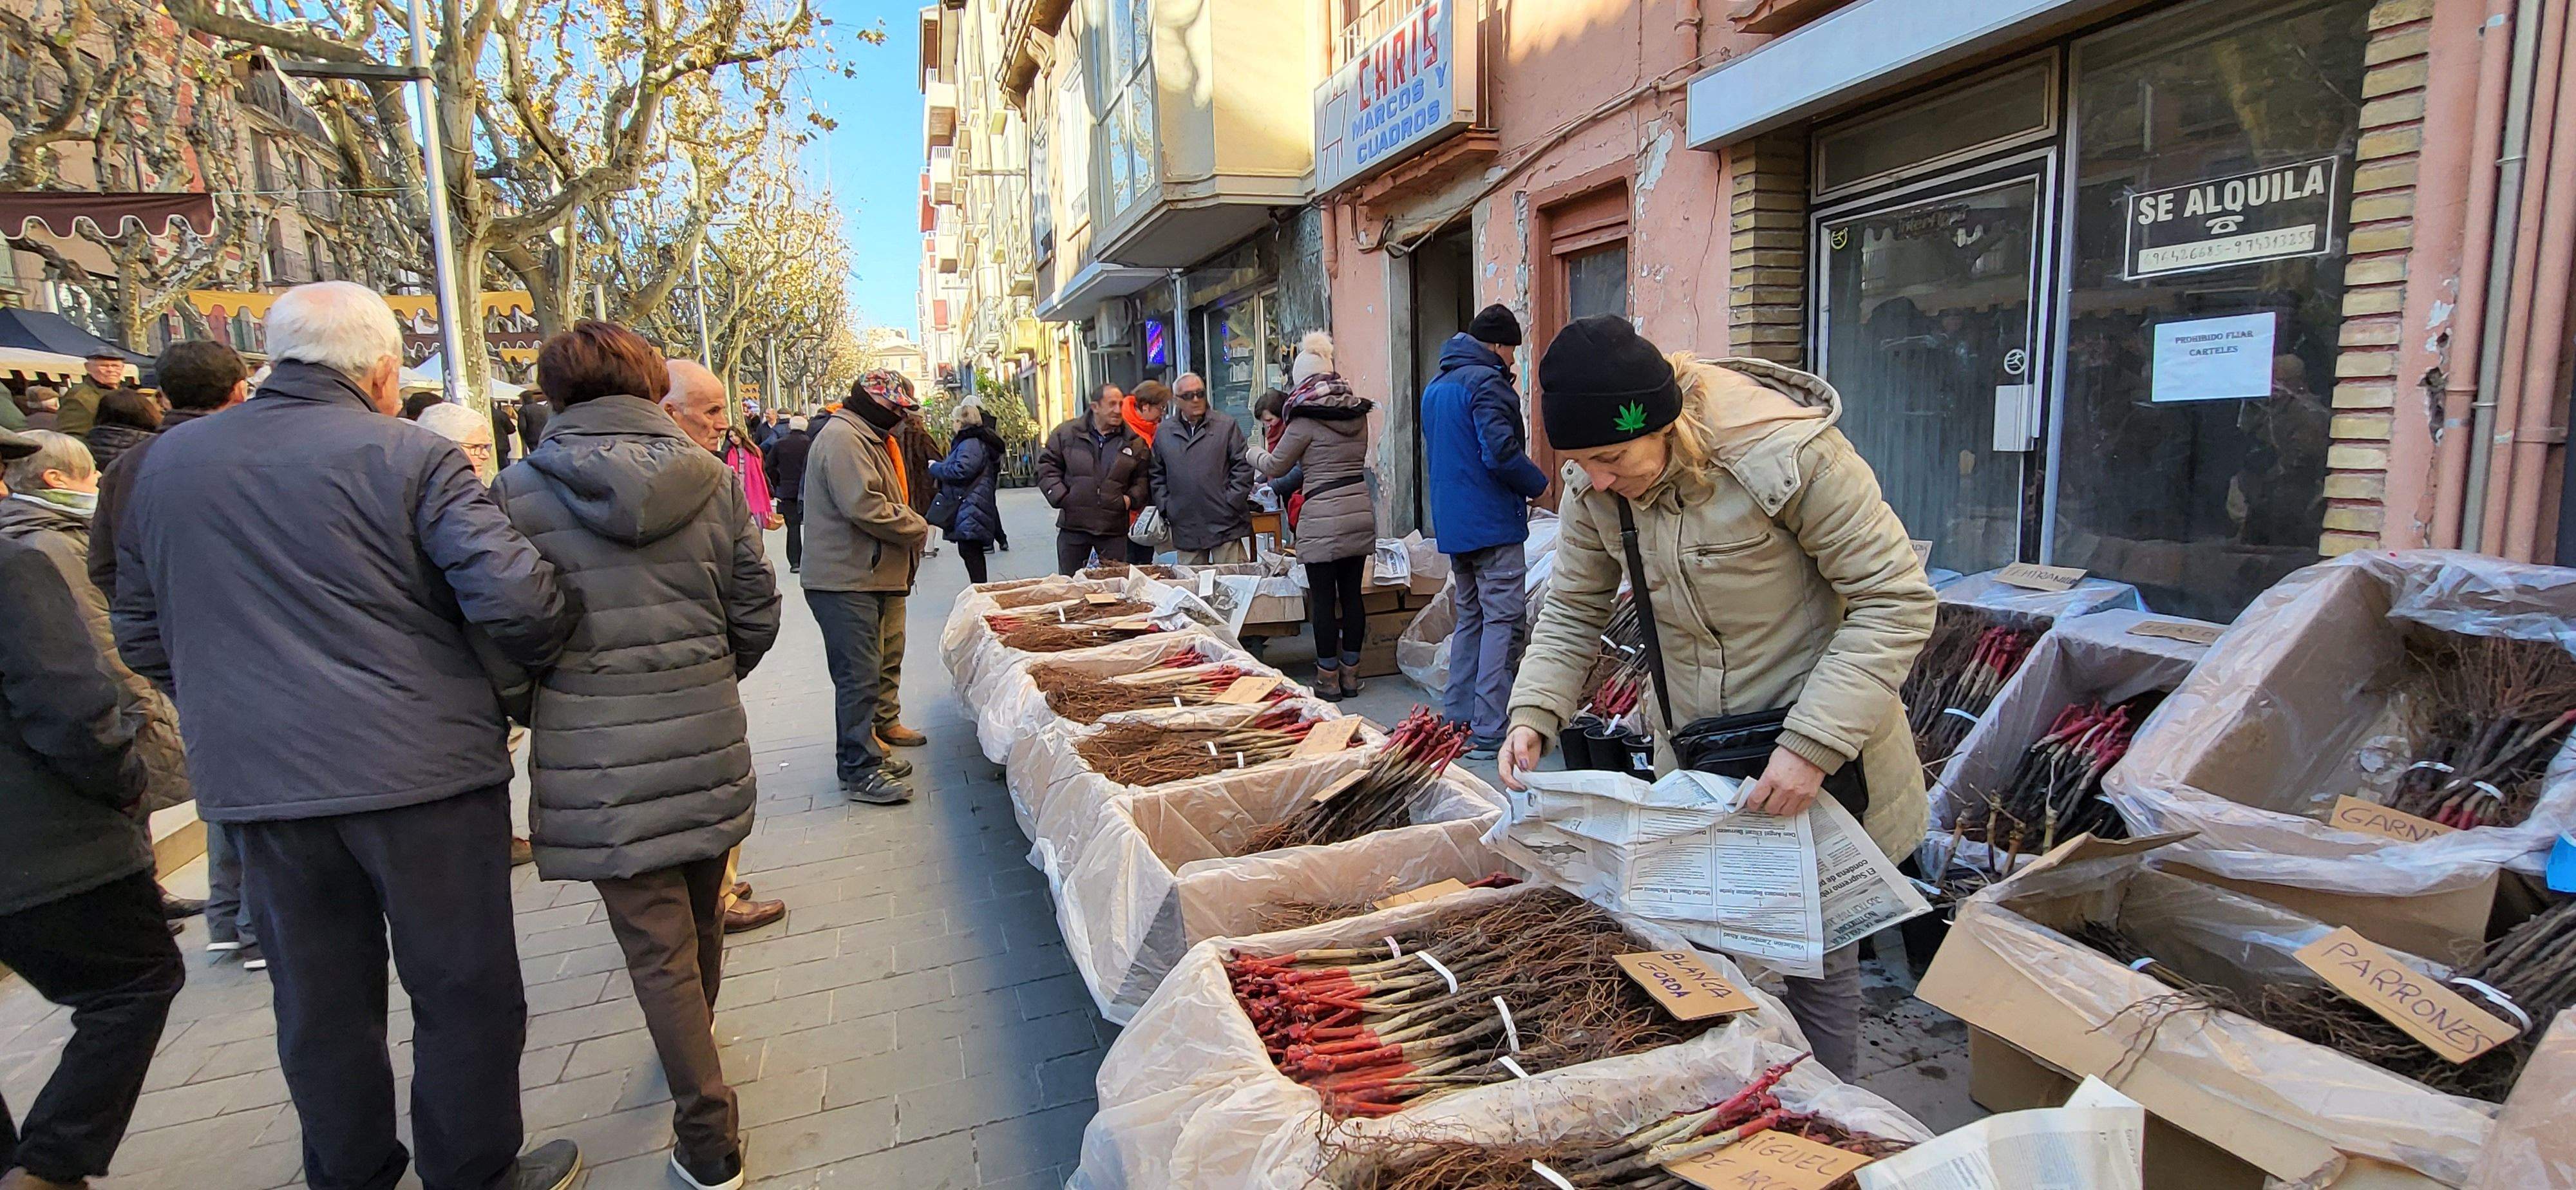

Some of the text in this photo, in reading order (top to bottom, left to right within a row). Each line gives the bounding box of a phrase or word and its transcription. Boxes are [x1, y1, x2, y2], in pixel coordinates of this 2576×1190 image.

[1359, 5, 1438, 112] CHRIS
[1352, 61, 1447, 142] MARCOS Y
[1357, 99, 1440, 165] CUADROS
[2137, 165, 2325, 225] SE ALQUILA
[2175, 332, 2223, 345] PROHIBIDO
[2189, 345, 2239, 357] CARTELES
[1826, 873, 1835, 883] de
[1836, 859, 1868, 878] condena
[1866, 867, 1876, 875] El
[1833, 872, 1866, 891] Supremo
[1638, 961, 1692, 998] GORDA
[1660, 953, 1732, 999] BLANCA
[2321, 941, 2498, 1054] PARRONES
[1688, 1151, 1736, 1169] DE
[1730, 1169, 1799, 1190] ARC
